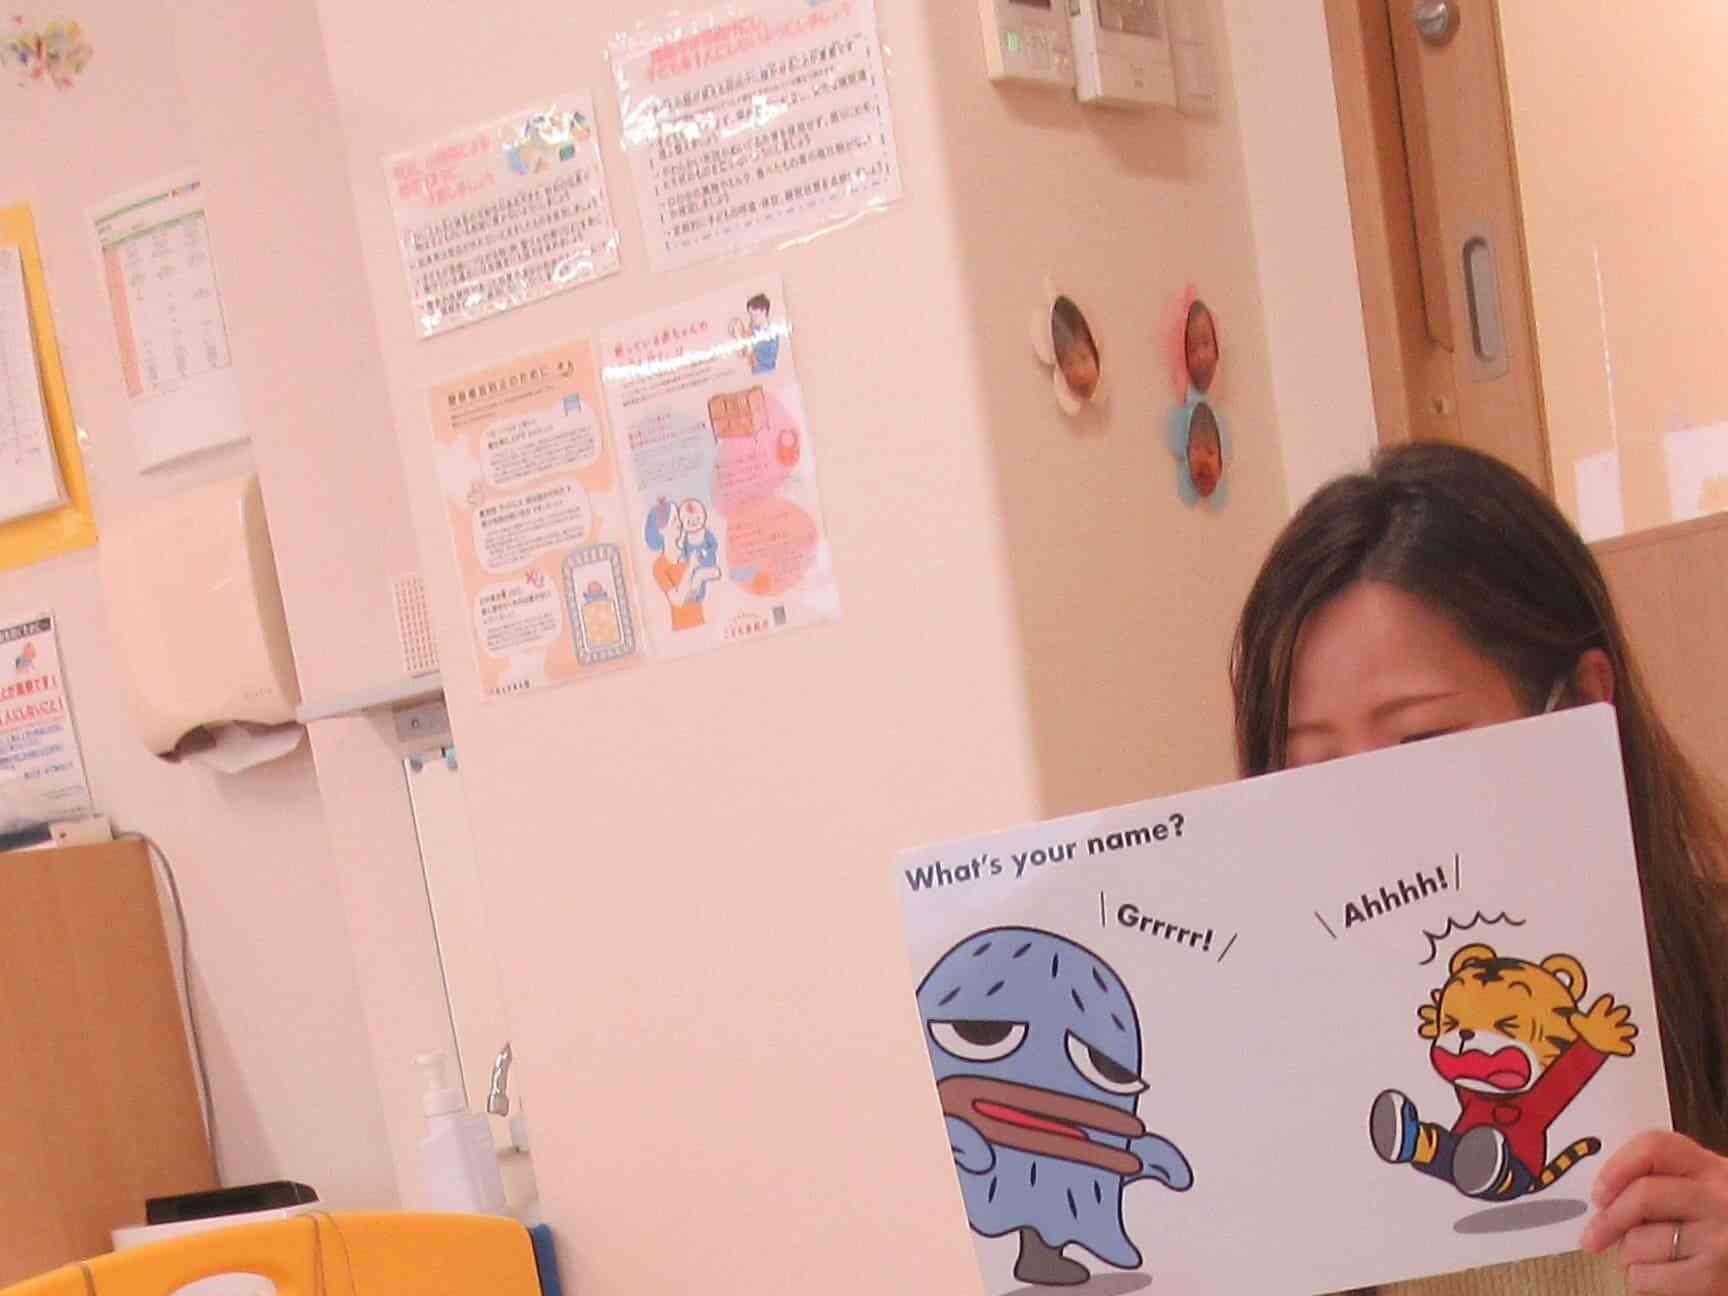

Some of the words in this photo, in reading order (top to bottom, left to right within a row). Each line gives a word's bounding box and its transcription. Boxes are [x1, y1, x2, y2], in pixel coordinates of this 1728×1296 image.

[904, 852, 1003, 892] What's
[1011, 841, 1078, 879] your
[1087, 813, 1186, 856] name?
[1117, 903, 1213, 952] Grrrrr!
[1344, 866, 1448, 928] Ahhhh!
